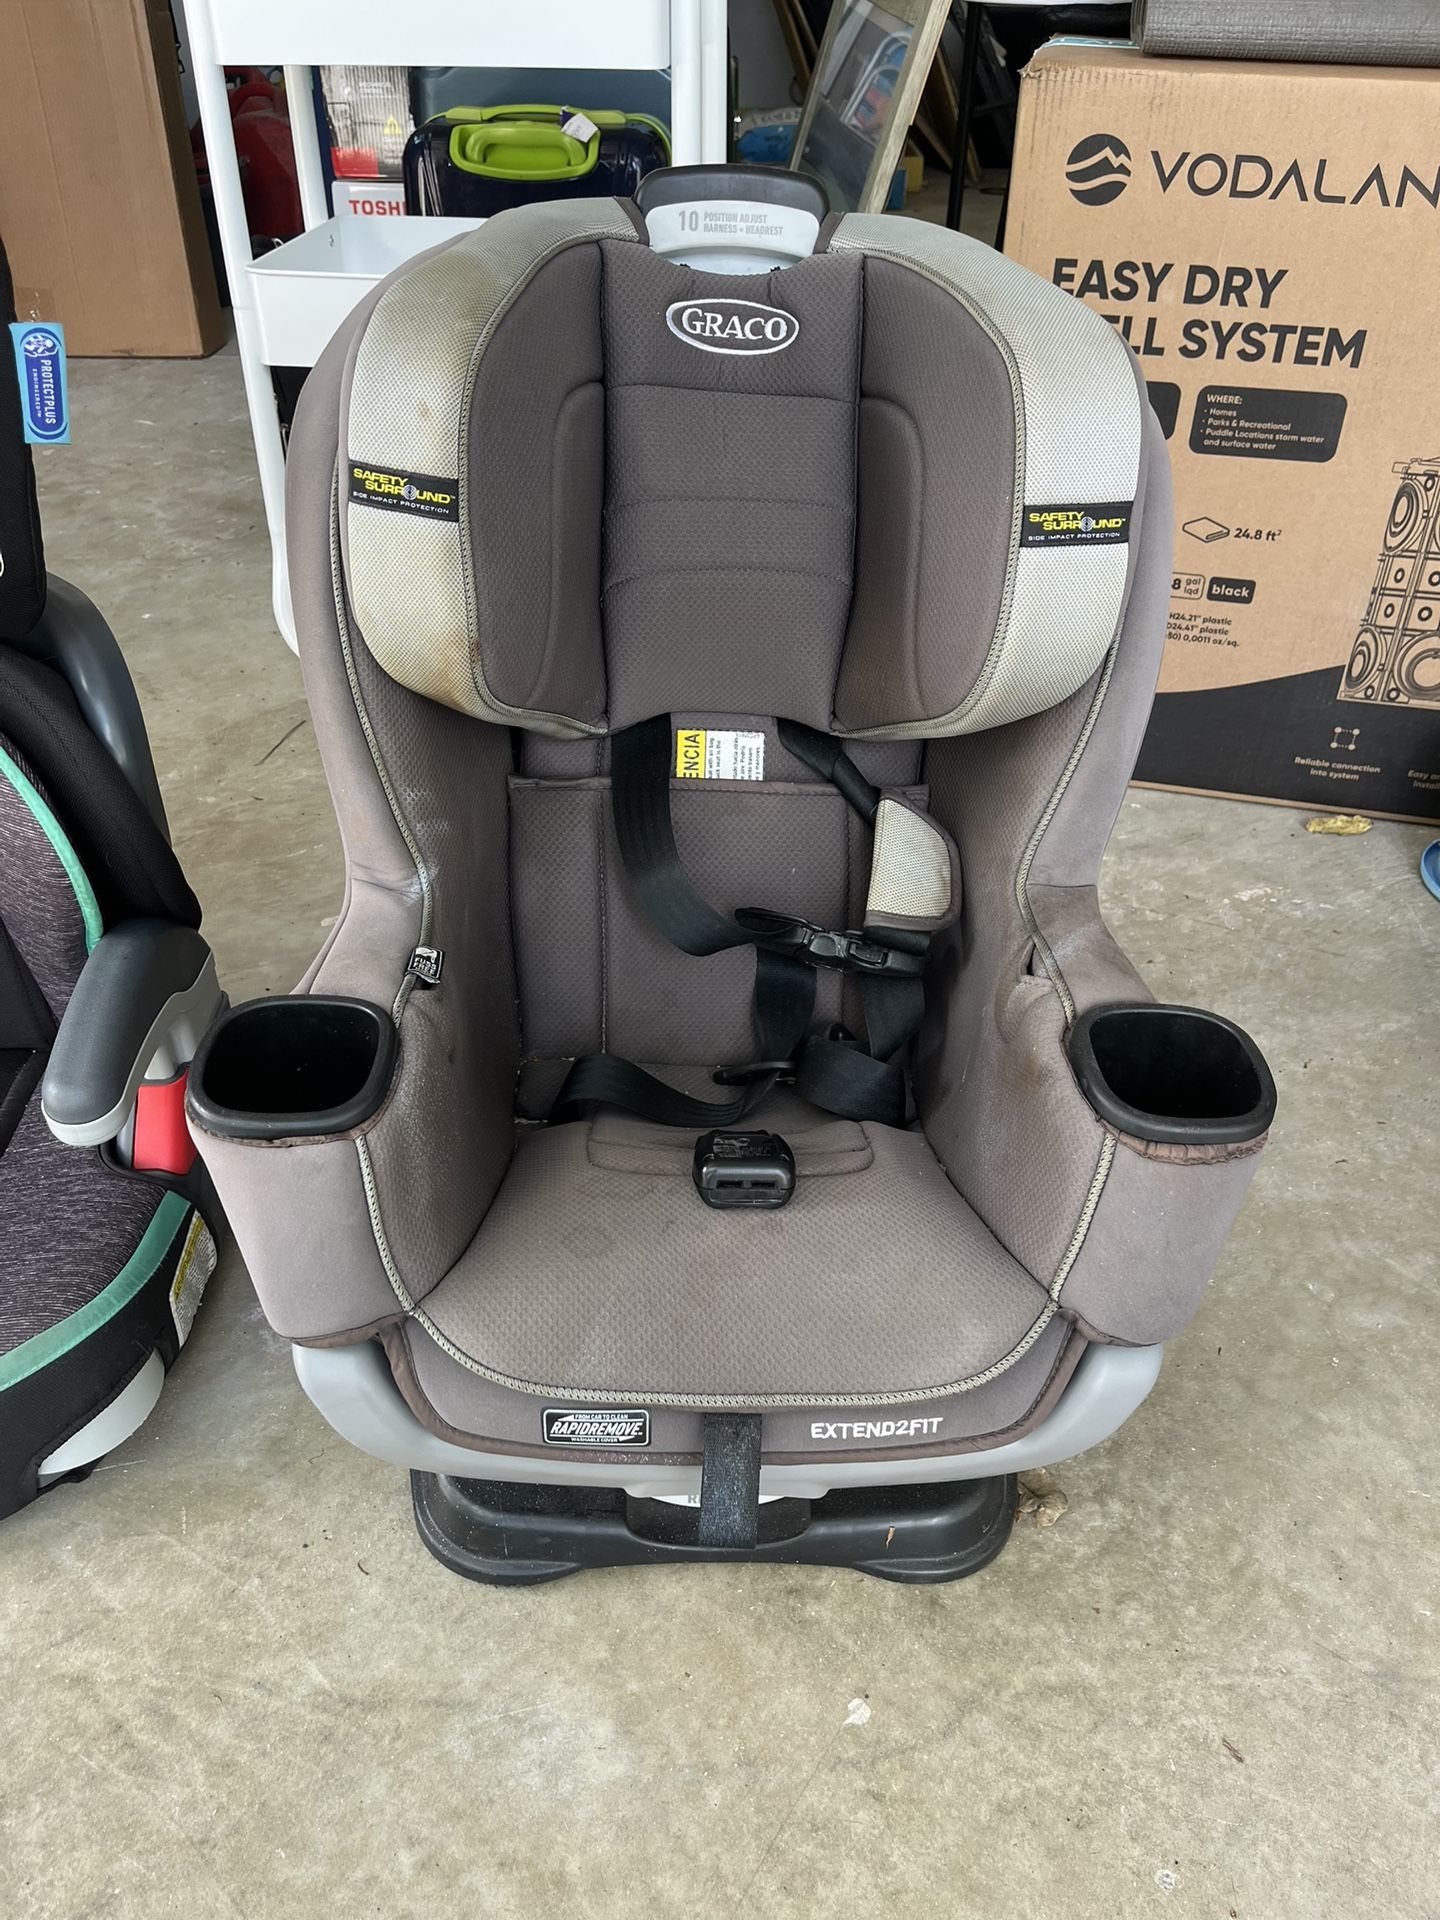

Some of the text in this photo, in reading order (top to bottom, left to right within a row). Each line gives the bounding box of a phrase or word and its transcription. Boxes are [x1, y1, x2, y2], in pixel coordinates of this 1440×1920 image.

[678, 210, 768, 232] 10 POSITION ADJUST
[703, 223, 738, 234] HARNESS
[745, 225, 784, 236] HEADREST
[1052, 258, 1289, 308] EASY DRY
[682, 308, 787, 341] GRACO
[1178, 319, 1367, 368] SYSTEM
[40, 359, 57, 424] PROTECTPLUS
[1206, 393, 1243, 405] WHERE:
[1209, 407, 1237, 417] Homes
[1207, 418, 1292, 431] Parks & Recreational
[1205, 428, 1325, 444] Puddle Locations storm water
[1203, 438, 1277, 450] and surface water
[353, 468, 408, 487] SAFETY
[353, 491, 449, 513] SIDE IMPACT PROTECTION
[1029, 511, 1085, 522] SAFETY
[1234, 527, 1262, 540] 24.8
[1185, 578, 1201, 587] gal
[1211, 584, 1250, 598] black
[1202, 615, 1232, 626] plastic
[1199, 625, 1229, 636] plastic
[1294, 756, 1381, 774] Reliable connection
[1329, 770, 1360, 781] system
[810, 1417, 943, 1440] EXTEND2FIT
